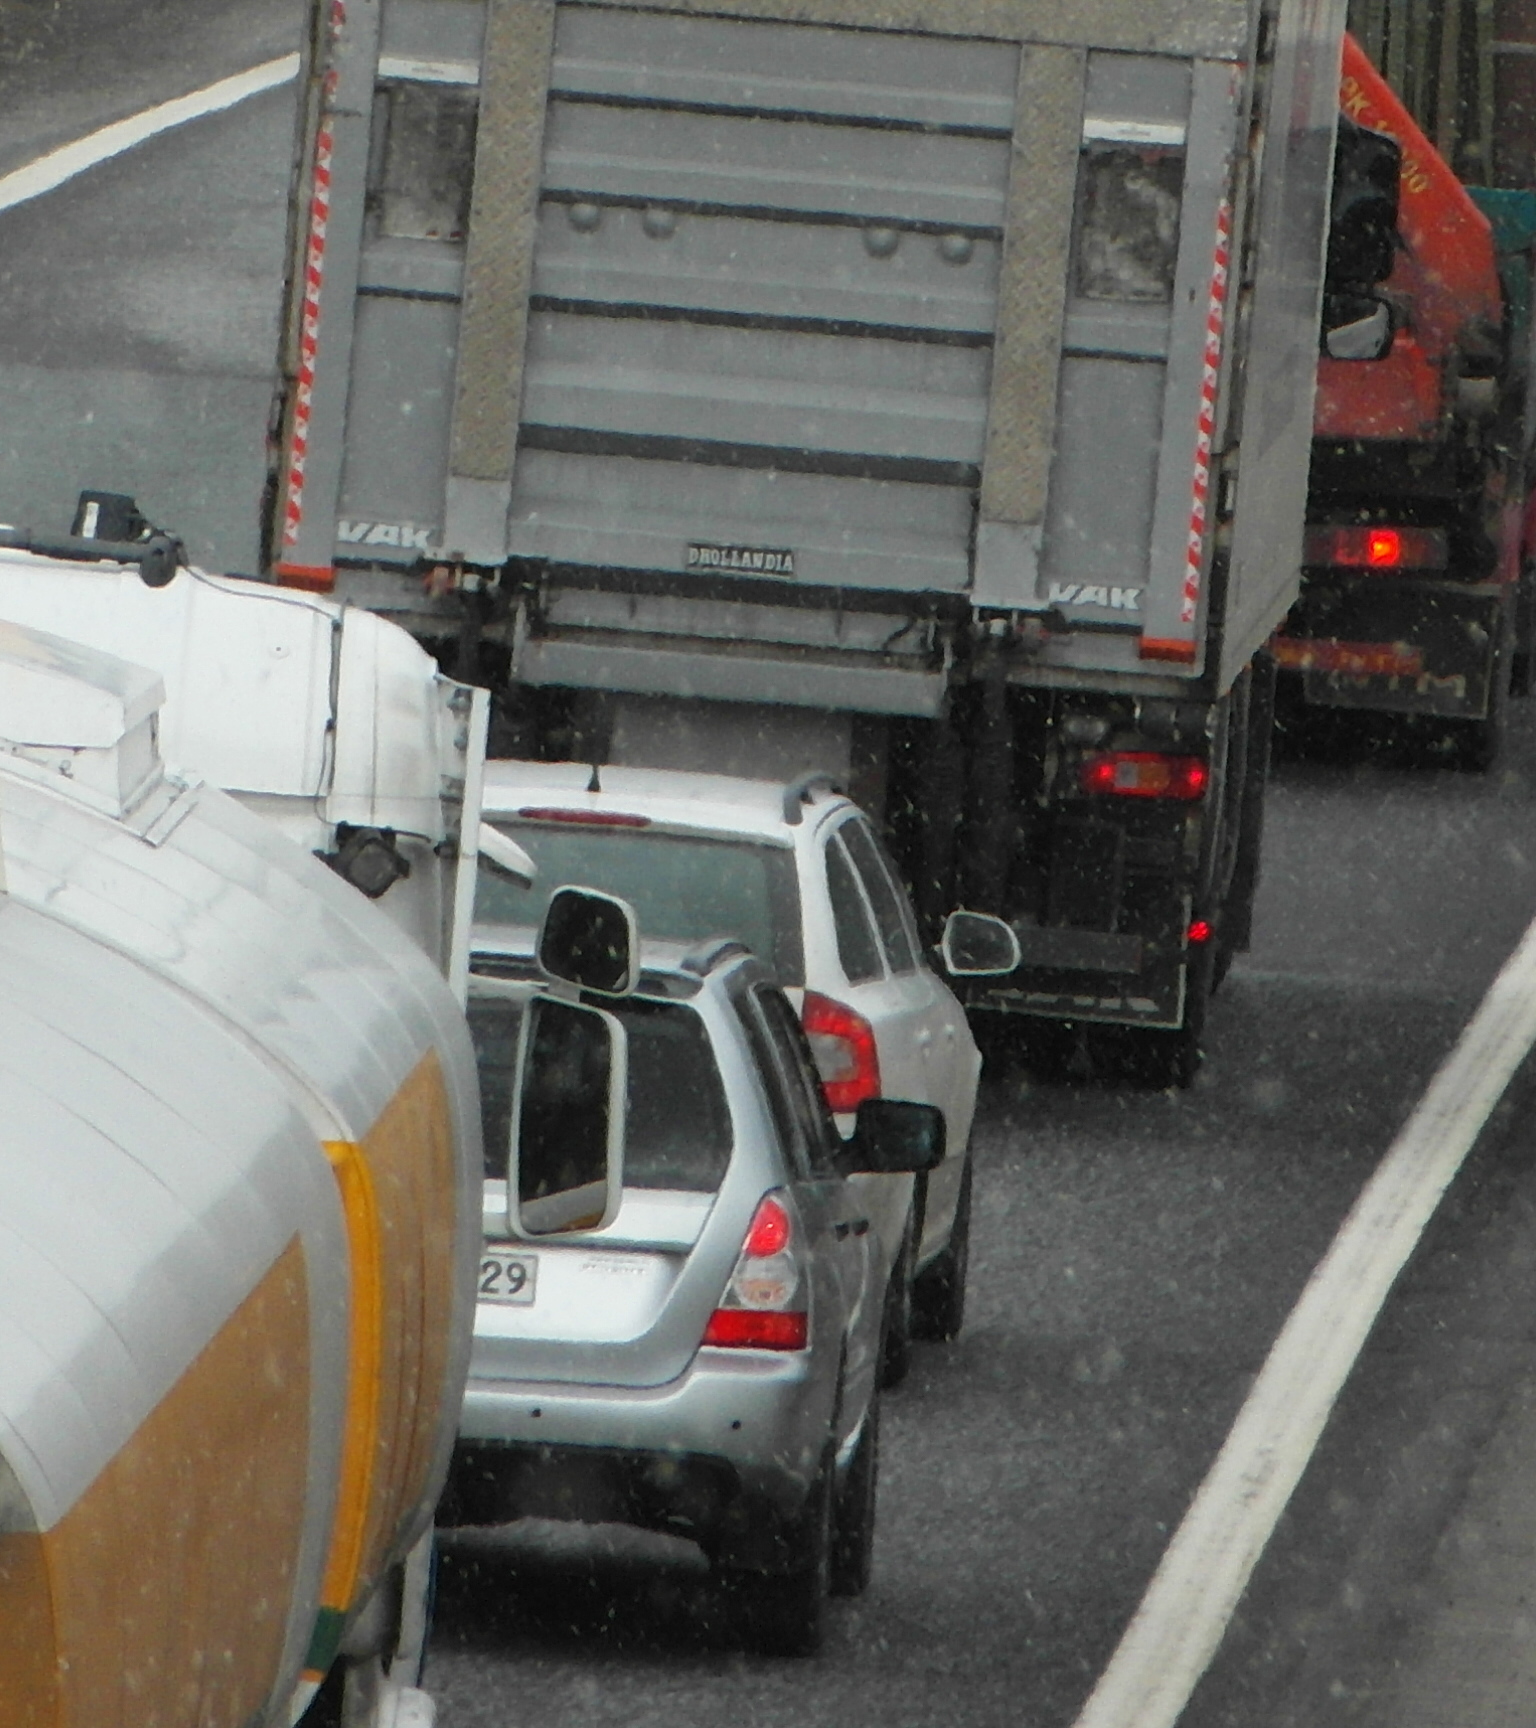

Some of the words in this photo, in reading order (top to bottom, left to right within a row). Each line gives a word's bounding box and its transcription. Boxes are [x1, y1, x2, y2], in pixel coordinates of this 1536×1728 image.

[337, 520, 430, 549] VAK
[687, 547, 794, 572] DHOLLANDIA
[1048, 582, 1141, 610] VAK
